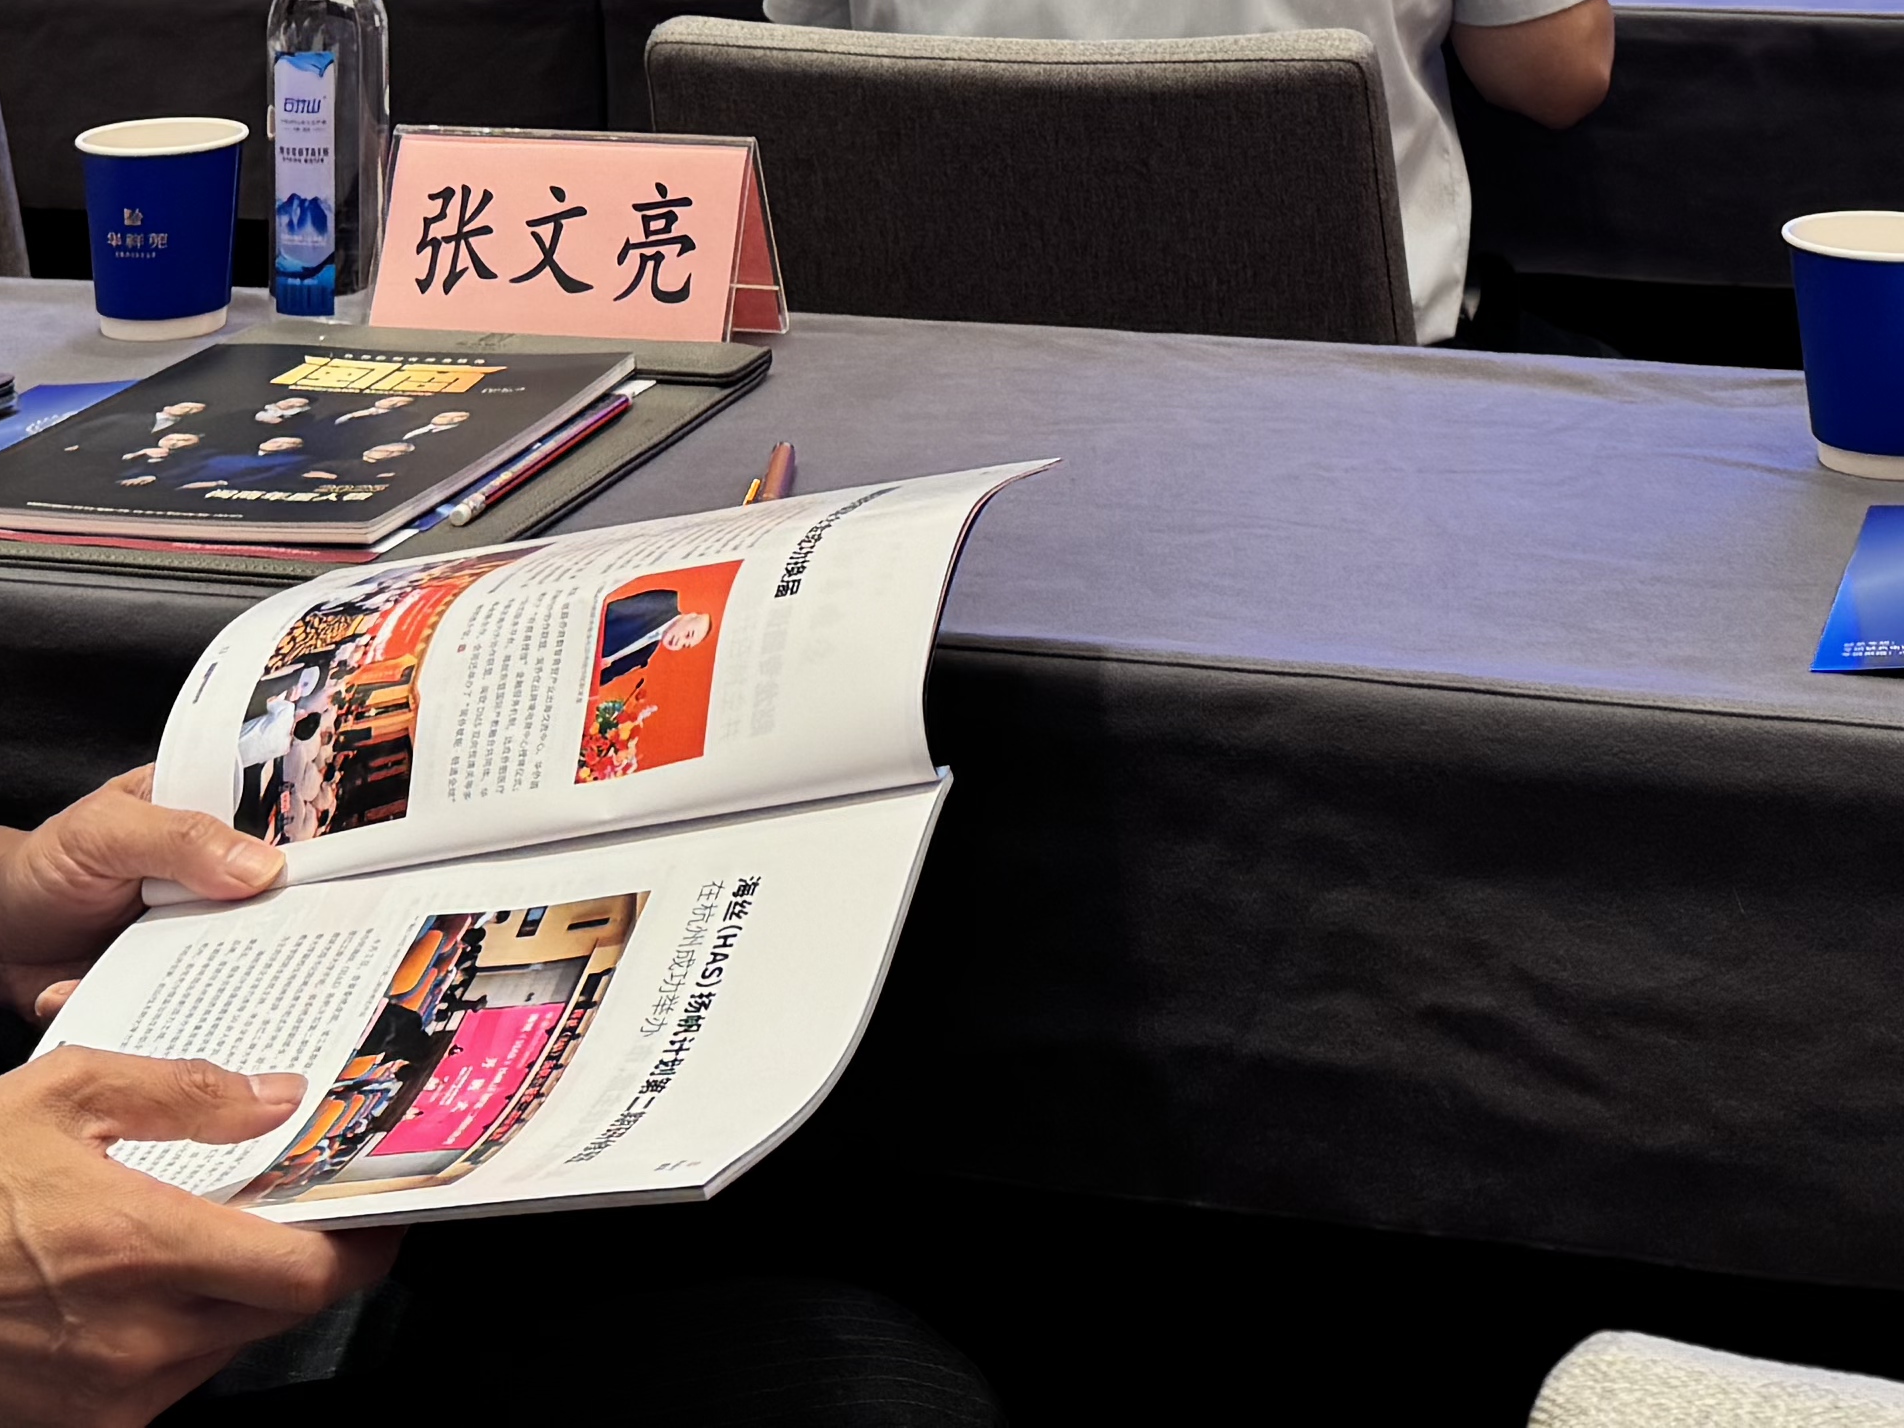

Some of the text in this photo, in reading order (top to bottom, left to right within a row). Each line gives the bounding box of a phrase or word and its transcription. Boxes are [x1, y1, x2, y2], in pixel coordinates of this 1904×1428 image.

[414, 181, 697, 304] 张文亮
[640, 879, 726, 1038] 在杭州成功举办
